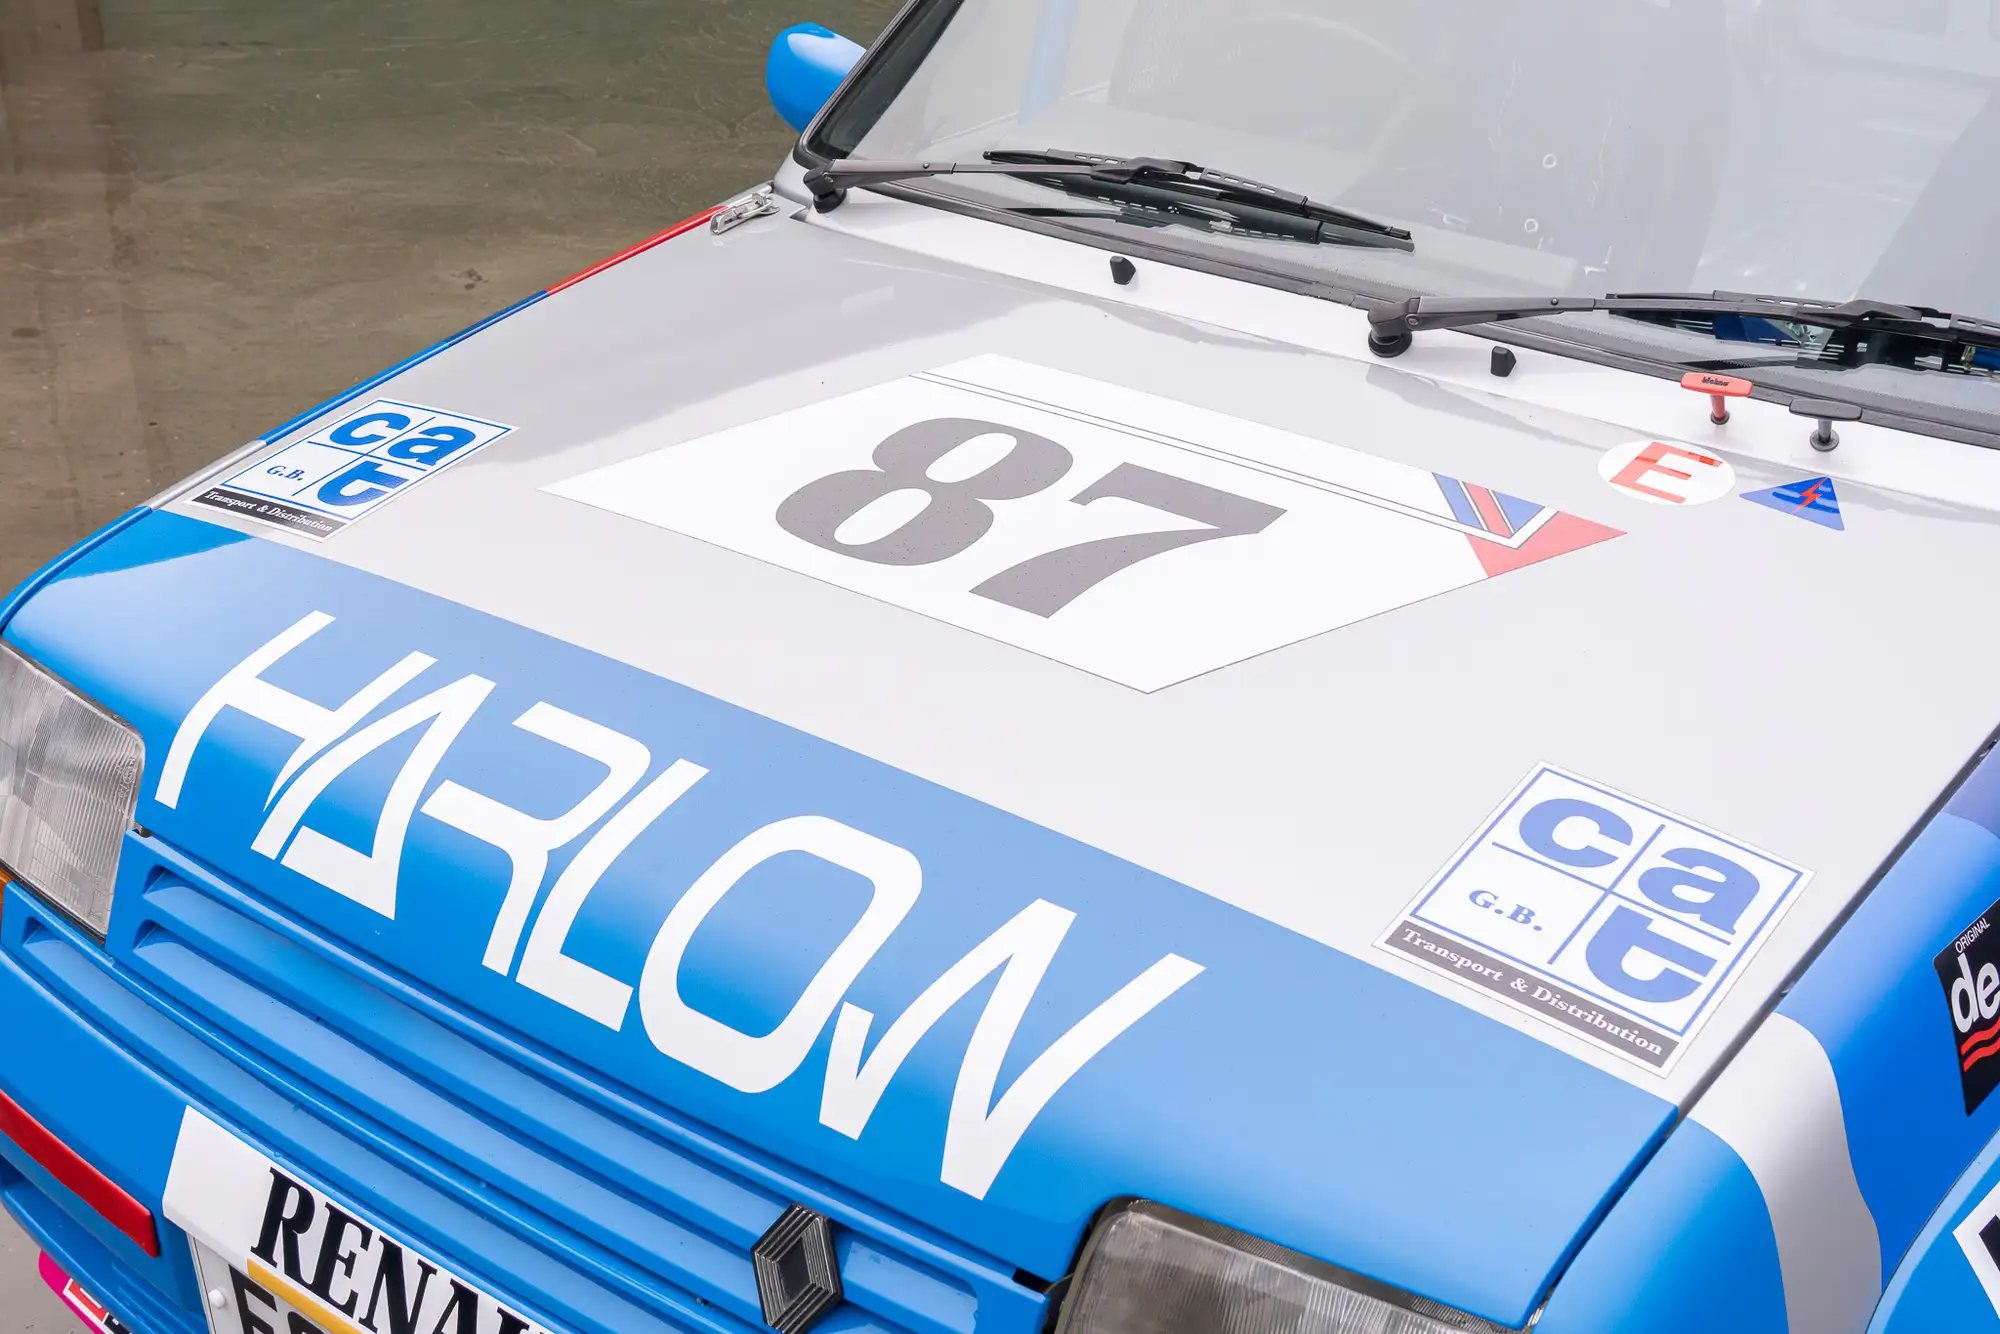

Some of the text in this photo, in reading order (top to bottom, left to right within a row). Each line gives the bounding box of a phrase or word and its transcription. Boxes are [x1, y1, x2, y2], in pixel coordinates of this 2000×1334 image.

[266, 465, 305, 481] G.B.
[1609, 441, 1723, 504] E
[204, 490, 333, 532] Transport & Distribution
[776, 417, 1288, 618] 87
[153, 610, 1206, 1201] HARLOW
[1469, 889, 1543, 932] G.B.
[1955, 917, 1990, 953] ORIGINAL
[1402, 928, 1663, 1056] Transport & Distribution
